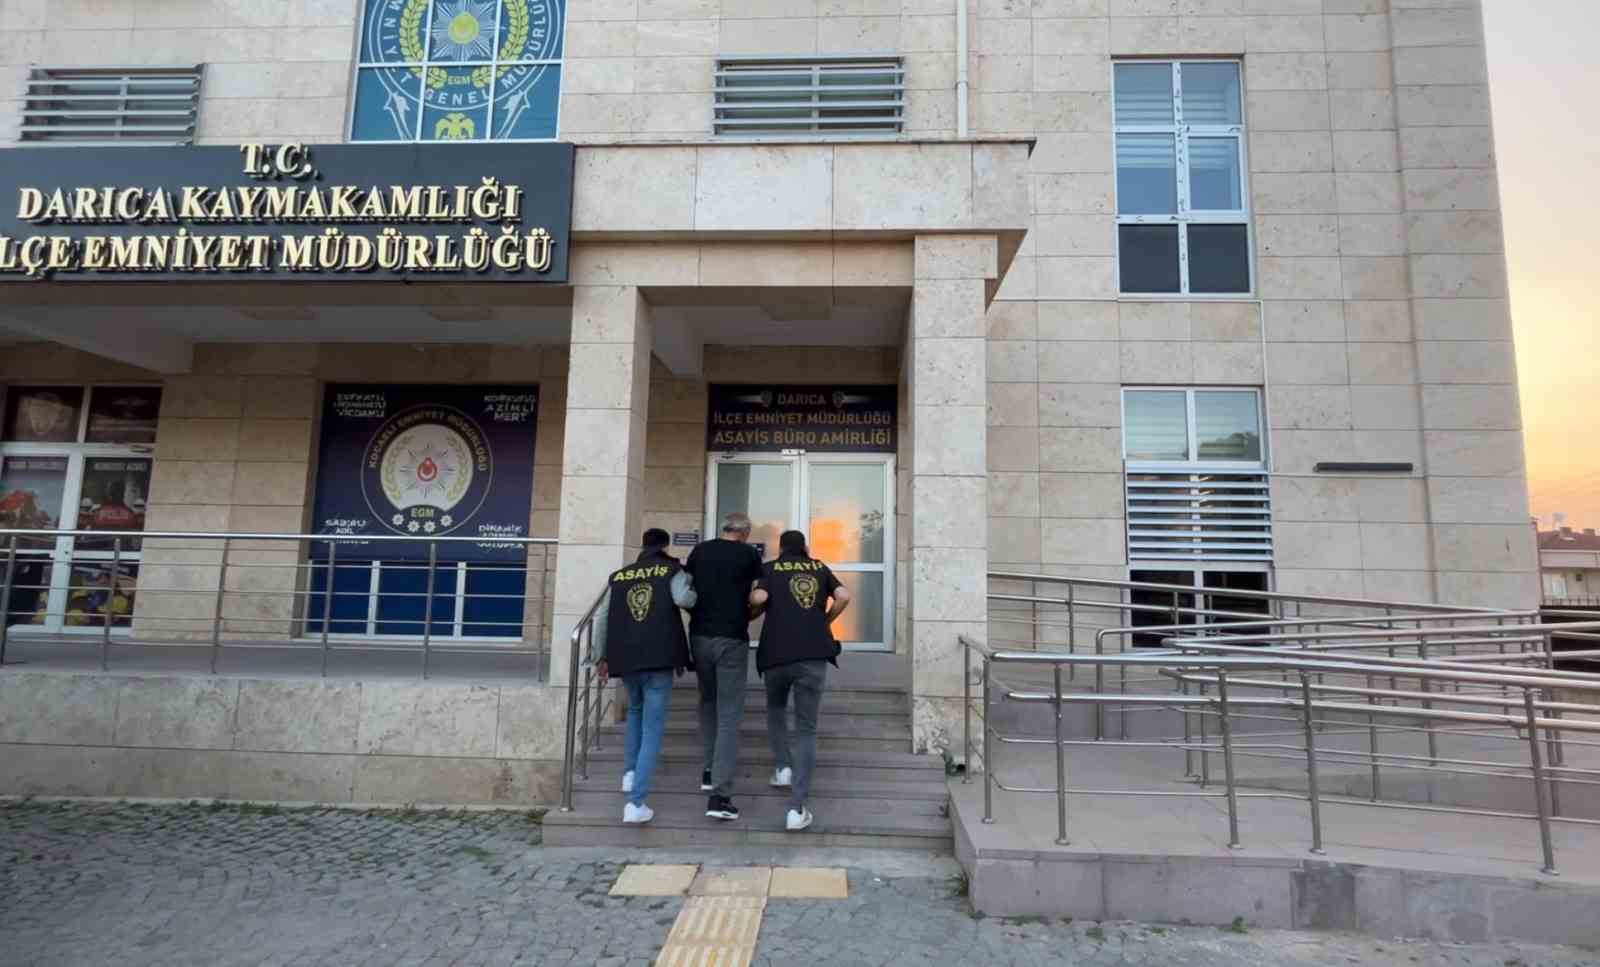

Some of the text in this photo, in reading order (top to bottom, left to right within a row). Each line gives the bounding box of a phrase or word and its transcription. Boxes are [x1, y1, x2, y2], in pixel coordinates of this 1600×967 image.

[425, 88, 490, 105] GENEL
[241, 143, 312, 174] T.C.
[16, 177, 519, 219] DARICA KAYMAKAMLIĞI
[0, 225, 551, 275] LÇE EMNİYET MÜDÜRLÜĞÜ
[746, 411, 803, 424] EMNİYET
[807, 410, 891, 424] MÜDÜRLÜĞÜ
[773, 428, 816, 444] BÜRO
[821, 428, 891, 444] AMİRLİĞİ
[411, 508, 434, 518] EGM
